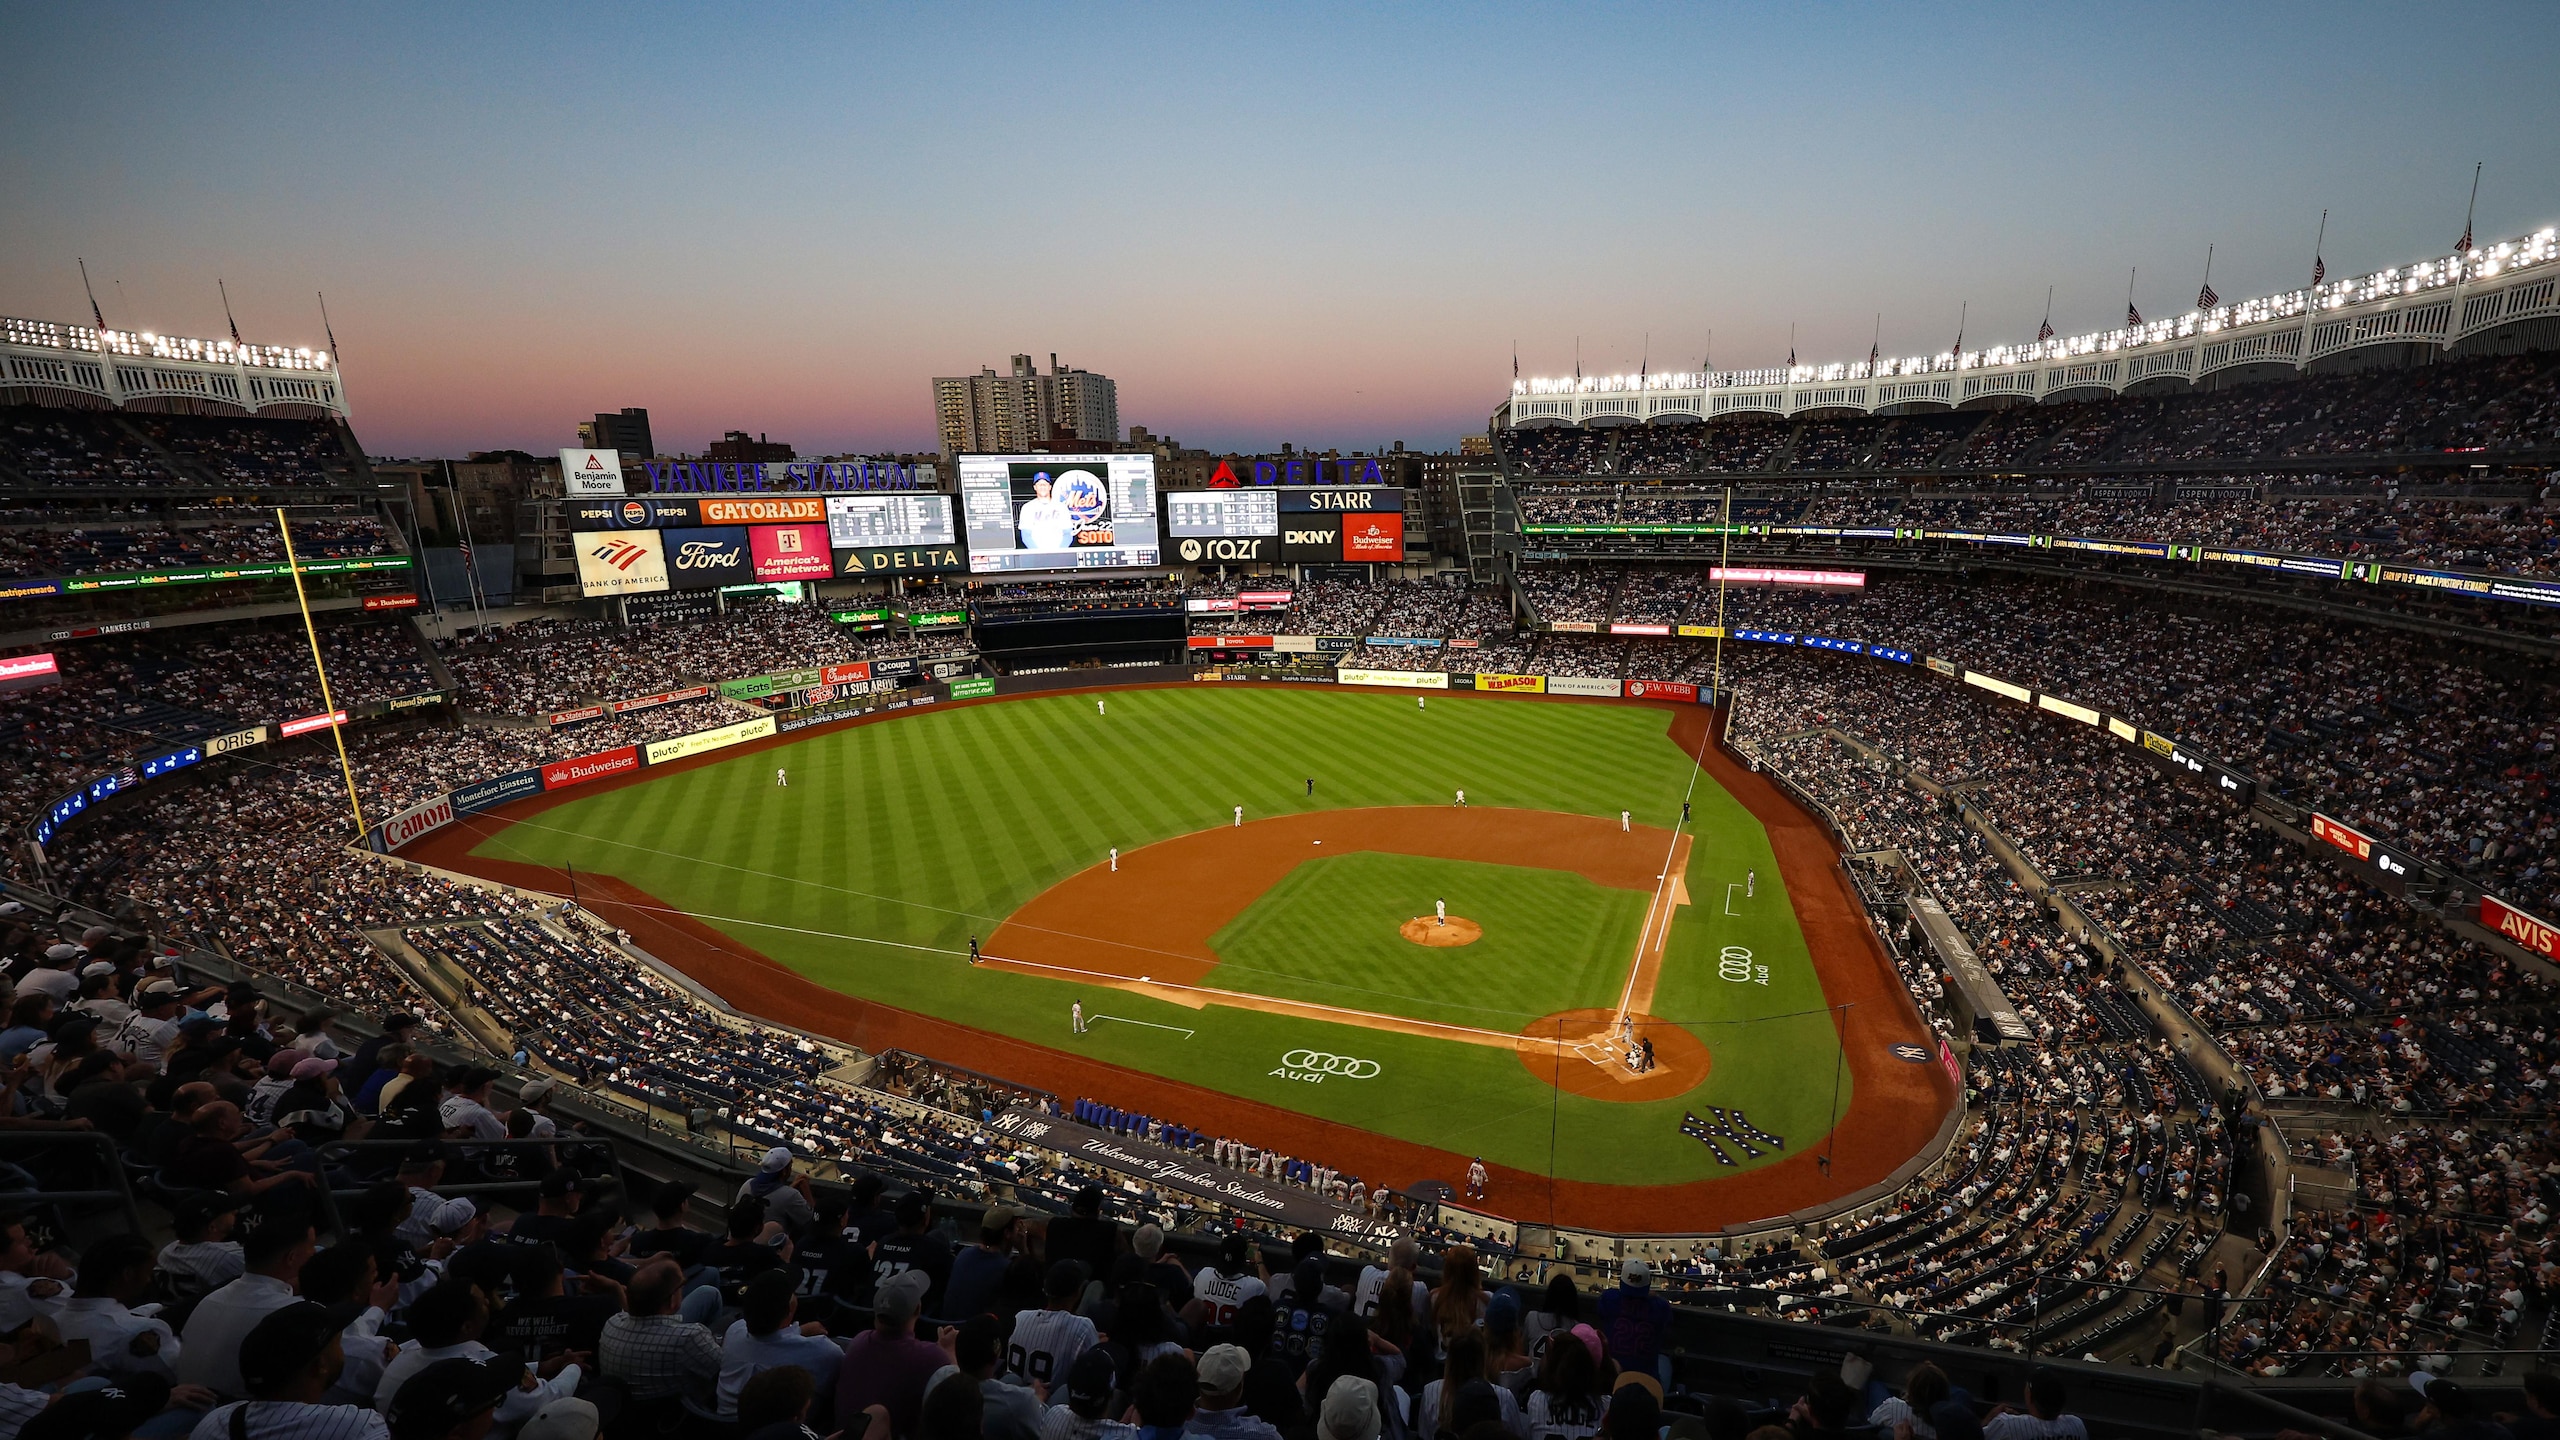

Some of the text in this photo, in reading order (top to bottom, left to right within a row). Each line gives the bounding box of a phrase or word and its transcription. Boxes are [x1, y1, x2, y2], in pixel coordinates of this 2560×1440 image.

[574, 471, 617, 482] Benjamin
[644, 462, 921, 493] YANKEE STADIUM
[1255, 460, 1384, 486] DELTA
[582, 481, 611, 489] Moore
[1309, 492, 1372, 510] STARR
[2094, 490, 2147, 498] ASPEN VODKA
[2180, 490, 2247, 498] ASPEN VODKA
[580, 509, 613, 519] PEPSI
[656, 508, 687, 517] PEPSI
[707, 501, 820, 521] GATORADE
[1078, 531, 1113, 545] SOTO
[1285, 530, 1337, 545] DKNY
[1353, 535, 1394, 545] Budweiser
[675, 541, 741, 570] Ford
[1206, 540, 1262, 560] razr
[764, 556, 820, 567] America's
[872, 550, 959, 570] DELTA
[2204, 551, 2255, 564] EARN FOUR FREE
[757, 563, 830, 576] Best Network
[583, 580, 609, 588] BANK
[624, 576, 665, 585] AMERICA
[2383, 570, 2395, 581] EARN
[2395, 572, 2402, 581] UP
[2401, 573, 2407, 583] TO
[2415, 574, 2433, 585] BACK
[2433, 577, 2439, 586] IN
[2438, 577, 2464, 590] PINSTRIPE
[380, 597, 417, 607] Budweiser
[838, 612, 879, 623] freshdirect
[918, 614, 960, 625] freshdirect
[100, 623, 132, 635] YANKEES
[132, 620, 150, 630] CLUB
[1569, 623, 1594, 631] Authority
[887, 660, 911, 671] coupa
[723, 686, 746, 697] Uber
[747, 681, 770, 694] Eats
[807, 685, 834, 697] Jersey
[842, 678, 899, 698] A SUB ABOVE
[1646, 682, 1691, 695] F.W. WEBB
[390, 693, 442, 710] Poland Spring
[887, 701, 909, 710] STARR
[782, 710, 860, 731] StubHub StubHub StubHub
[216, 731, 255, 752] ORIS
[653, 746, 679, 760] pluto
[740, 725, 764, 739] pluto
[570, 755, 635, 779] Budweiser
[456, 780, 499, 806] Montefiore
[499, 774, 534, 792] Einstein
[384, 801, 452, 847] Canon
[2501, 911, 2553, 953] AVIS
[1754, 964, 1769, 986] Audi
[1268, 1067, 1326, 1084] Audi
[1024, 1124, 1050, 1136] YORK
[1031, 1121, 1052, 1132] NEW
[1019, 1129, 1040, 1140] LIFE
[1081, 1138, 1285, 1210] Welcome to Yankee Stadium
[1331, 1218, 1362, 1234] YORK
[1337, 1213, 1364, 1225] NEW
[801, 1250, 823, 1260] GROOM
[883, 1243, 912, 1253] BEST MAN
[1204, 1280, 1241, 1302] JUDGE
[516, 1316, 556, 1325] WE WILL
[505, 1323, 569, 1337] NEVER FORGET
